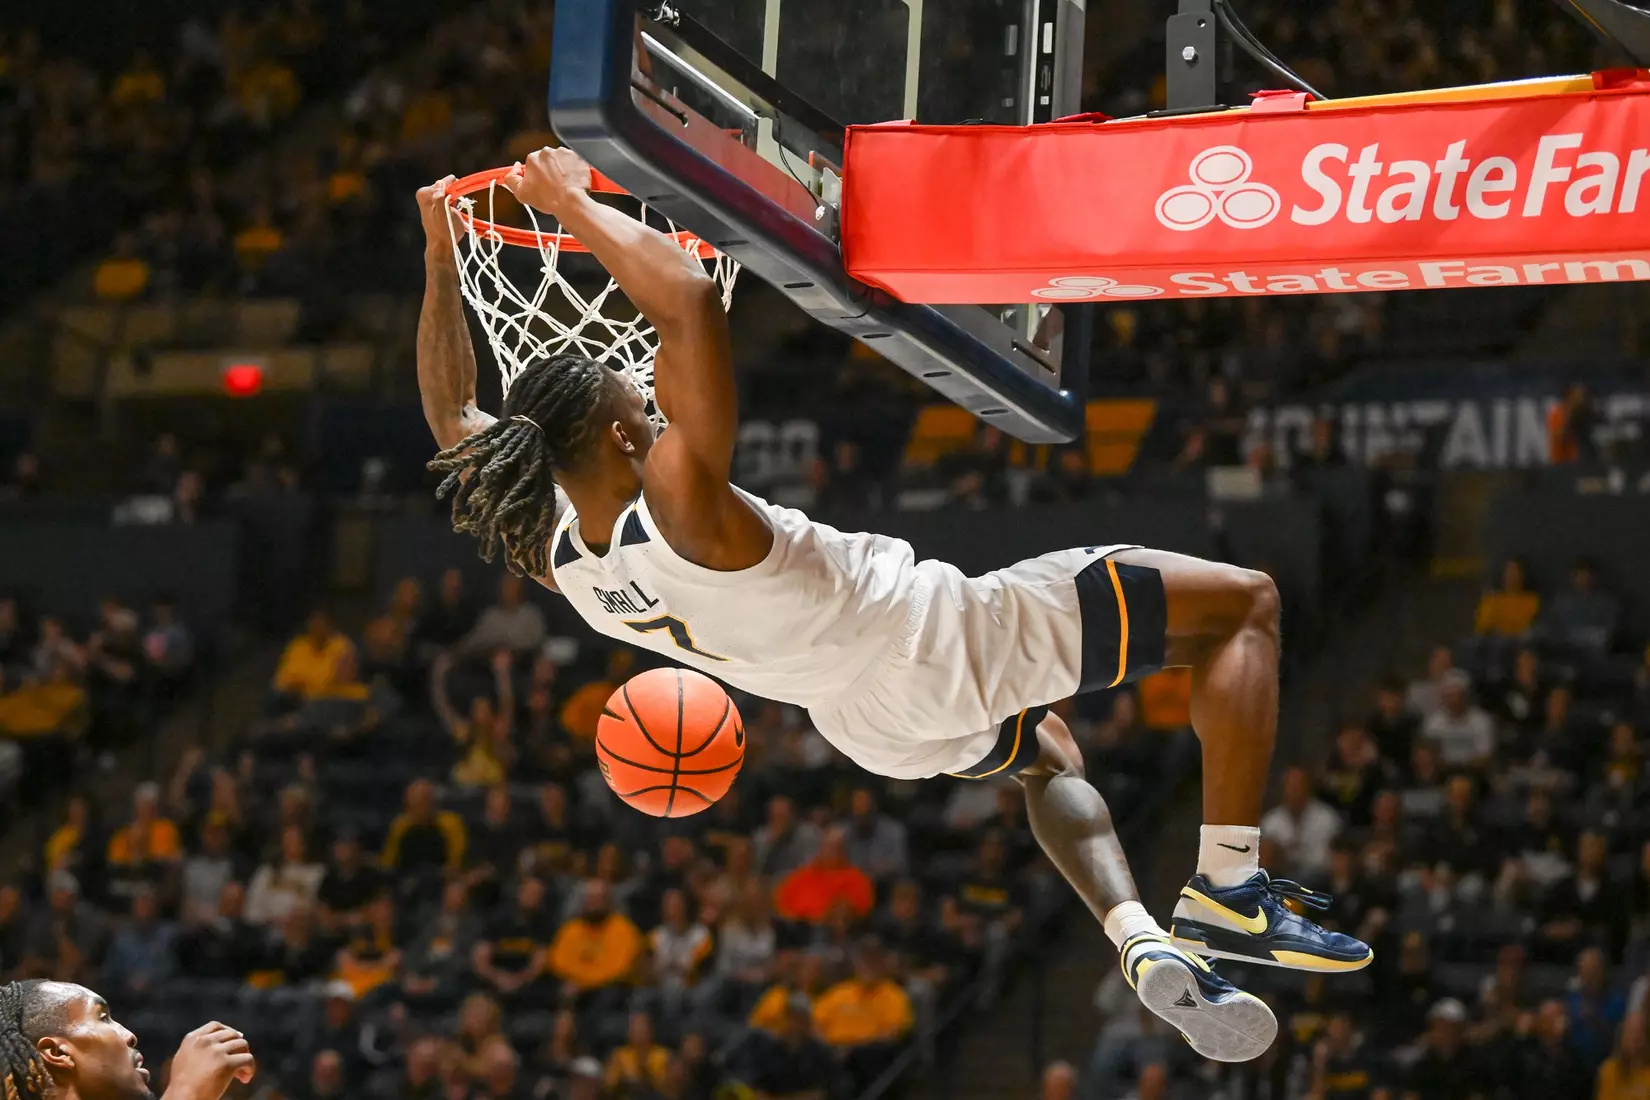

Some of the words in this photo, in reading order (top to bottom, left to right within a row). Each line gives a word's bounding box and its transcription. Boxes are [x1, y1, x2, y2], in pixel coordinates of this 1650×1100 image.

[1291, 139, 1518, 226] State
[1169, 268, 1410, 295] State
[1417, 258, 1650, 287] Farm
[593, 580, 659, 613] SMALL
